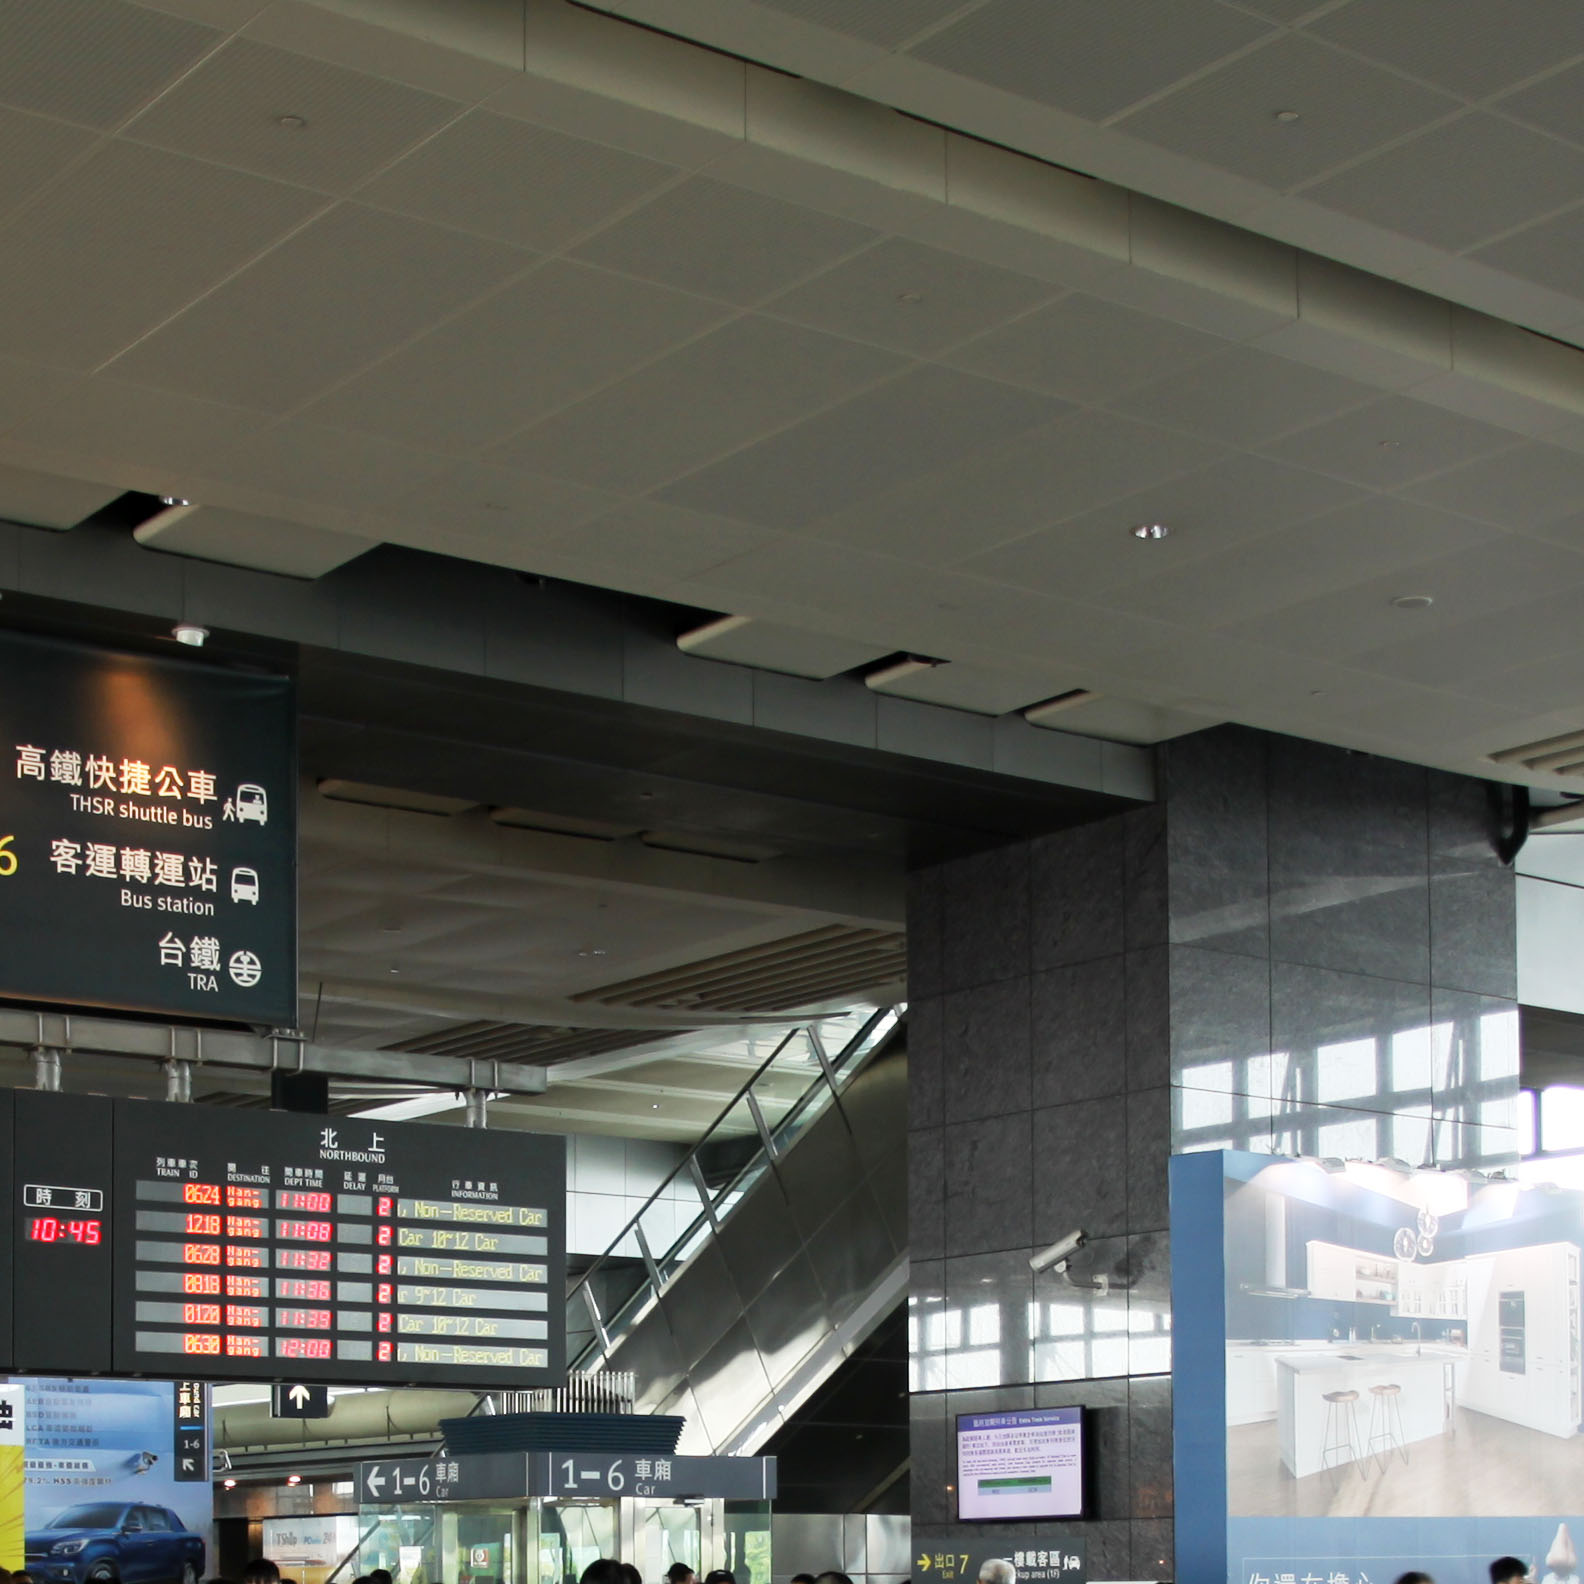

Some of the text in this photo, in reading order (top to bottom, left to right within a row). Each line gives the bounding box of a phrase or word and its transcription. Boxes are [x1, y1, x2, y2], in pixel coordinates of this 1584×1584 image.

[16, 744, 217, 804] 高鐵快捷公車
[70, 794, 213, 830] THSR shuttle bus
[50, 839, 218, 893] 客運轉運站
[120, 888, 215, 917] Bus station
[158, 932, 220, 972] 台鐵
[187, 972, 219, 993] TRA
[319, 1149, 385, 1164] NORTHBOUND
[156, 1168, 180, 1177] TRAIN
[227, 1173, 271, 1184] DESTINATION
[284, 1176, 323, 1188] DEPT TIME
[183, 1183, 221, 1206] 0624
[343, 1180, 366, 1191] DELAY
[451, 1189, 498, 1200] INFORMATION
[35, 1187, 91, 1209] 時刻
[279, 1191, 332, 1212] 11:00
[377, 1196, 393, 1217] 2
[185, 1213, 222, 1235] 1218
[519, 1208, 542, 1225] Car
[30, 1217, 101, 1245] 10:45
[280, 1220, 333, 1242] 11:08
[398, 1228, 498, 1251] Car Car
[519, 1264, 543, 1281] Car
[452, 1289, 477, 1306] Car
[475, 1318, 499, 1336] Car
[519, 1348, 544, 1365] Car
[184, 1439, 200, 1449] 1-6
[392, 1460, 459, 1495] 1-6 車廂
[561, 1458, 672, 1492] 1-6 車廂
[435, 1486, 449, 1498] Car
[635, 1482, 655, 1495] Car
[934, 1553, 969, 1574] 出口 7
